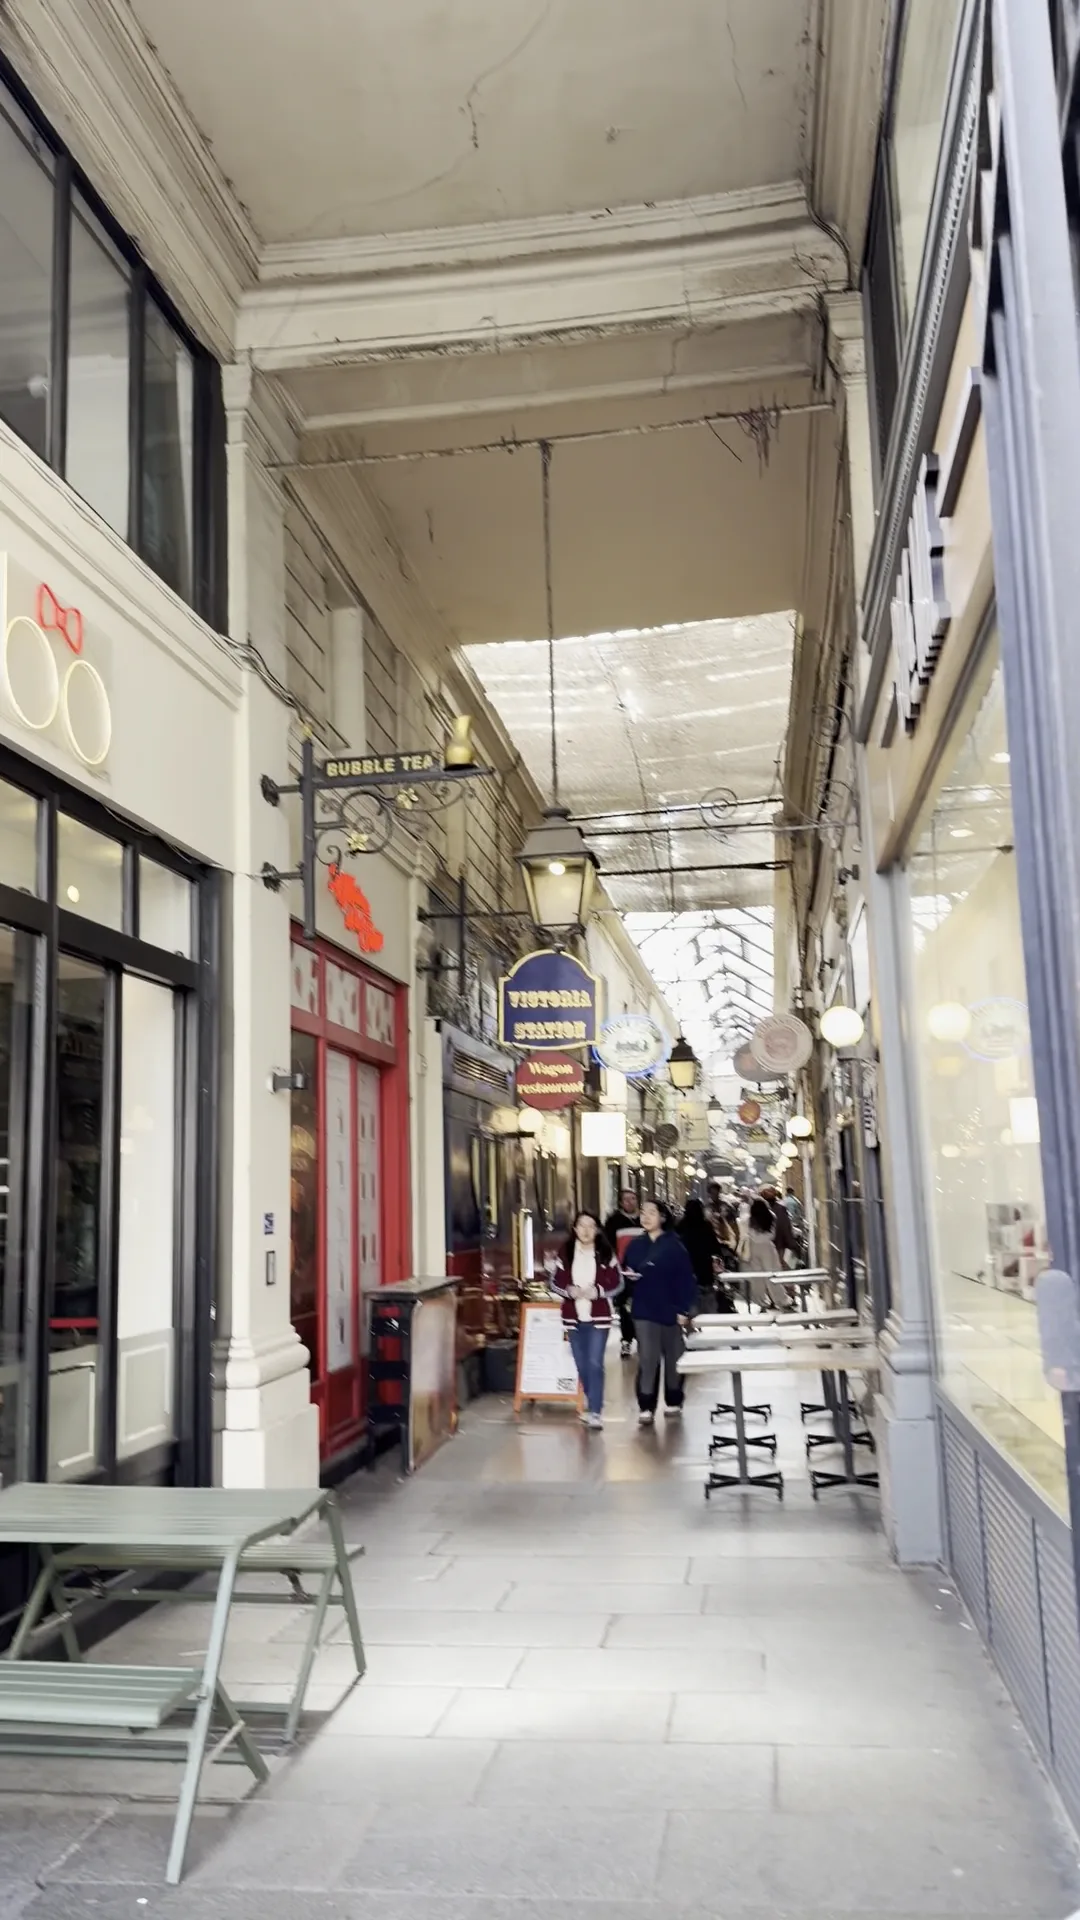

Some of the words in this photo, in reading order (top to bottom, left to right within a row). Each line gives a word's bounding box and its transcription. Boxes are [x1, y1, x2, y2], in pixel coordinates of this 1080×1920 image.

[326, 757, 395, 777] BUBBLE
[401, 754, 434, 771] TEA
[508, 990, 592, 1008] VICTORIA
[513, 1020, 587, 1040] STATION
[527, 1061, 574, 1077] Wagon
[516, 1080, 585, 1095] restaurant
